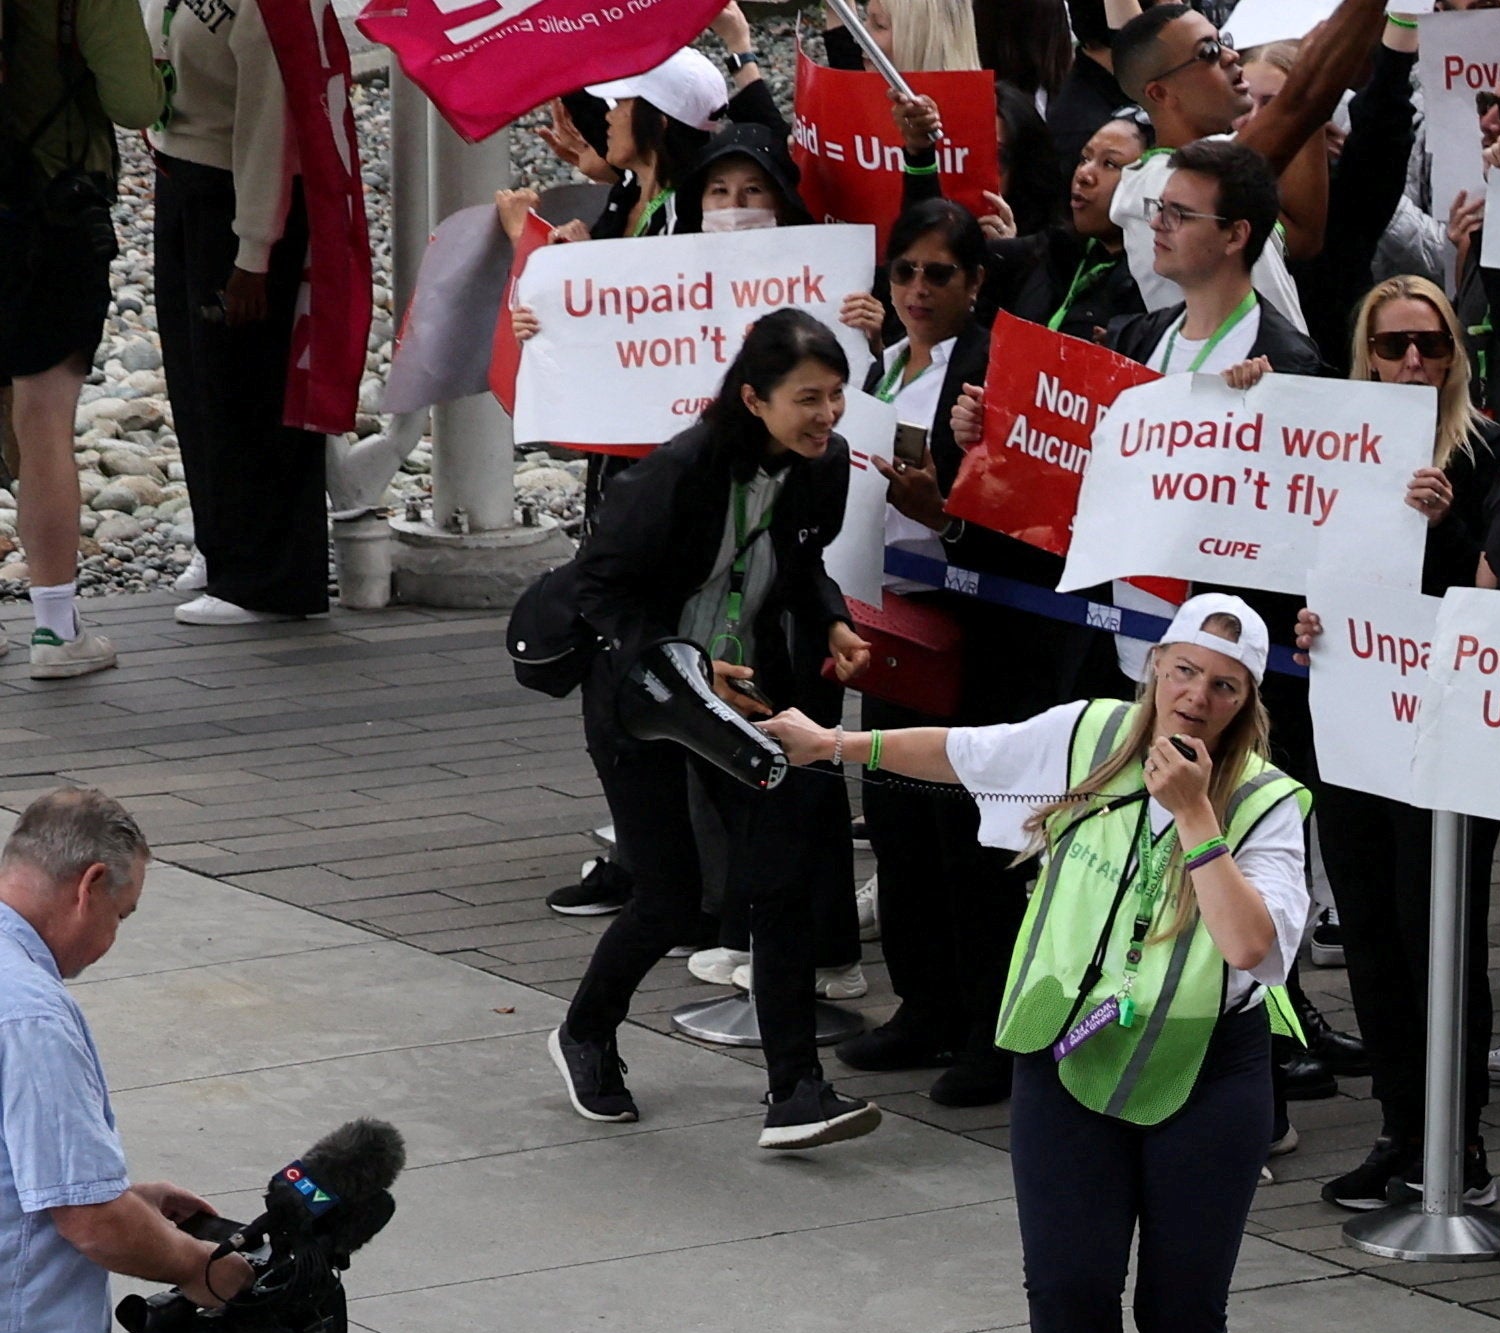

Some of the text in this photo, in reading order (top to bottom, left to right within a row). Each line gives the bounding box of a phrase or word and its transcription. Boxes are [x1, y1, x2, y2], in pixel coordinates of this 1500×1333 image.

[825, 141, 844, 162] =
[564, 266, 826, 323] Unpaid work
[616, 331, 727, 368] won't
[1035, 370, 1090, 425] Non
[1120, 412, 1264, 460] Unpaid
[1281, 422, 1383, 465] work
[1151, 469, 1339, 527] won't fly
[1198, 538, 1261, 561] CUPE
[1086, 611, 1120, 632] YVR
